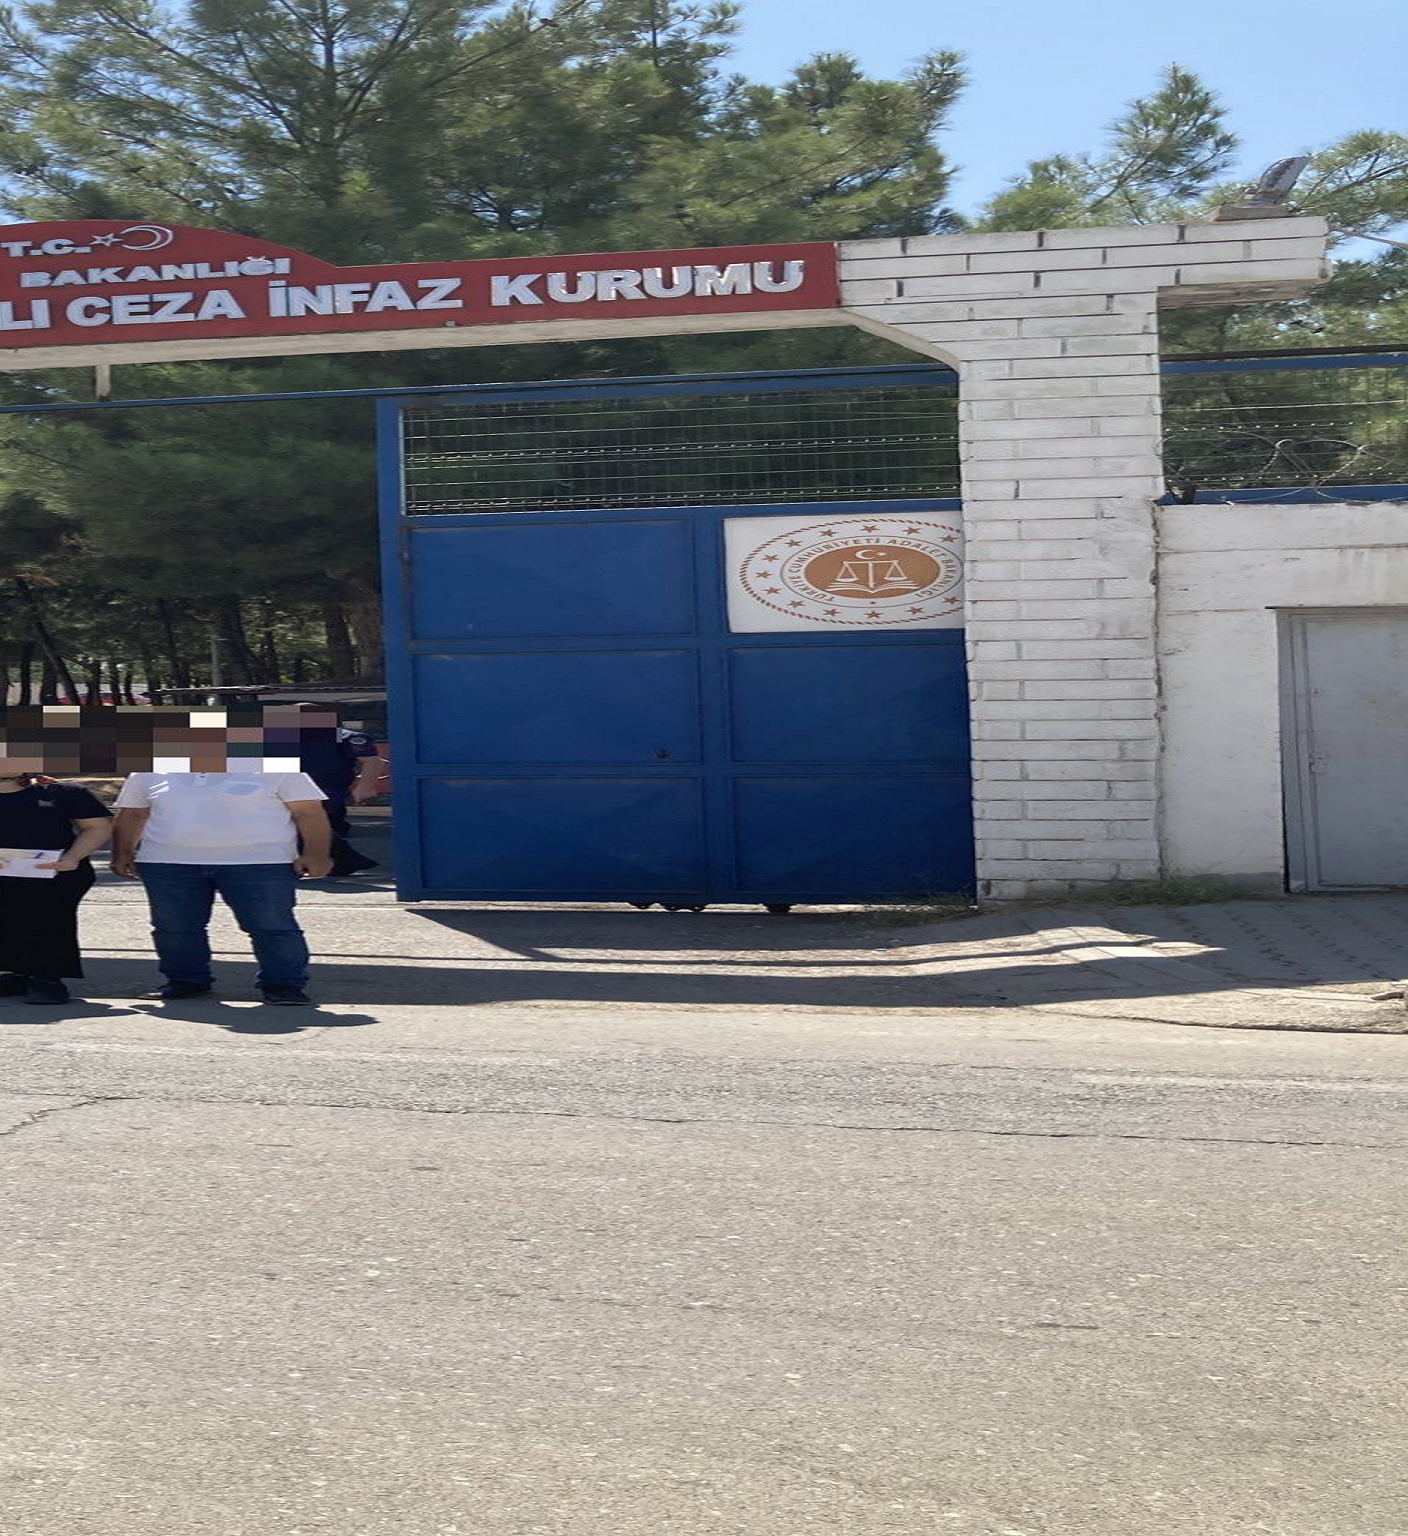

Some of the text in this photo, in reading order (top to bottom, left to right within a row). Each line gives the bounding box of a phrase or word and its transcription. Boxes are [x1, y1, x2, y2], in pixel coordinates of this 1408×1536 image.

[0, 239, 91, 257] T.C.
[20, 256, 290, 288] BAKANLIĞI
[66, 290, 245, 326] CEZA
[269, 278, 463, 317] İNFAZ
[492, 259, 805, 306] KURUMU
[887, 539, 946, 557] ADALET
